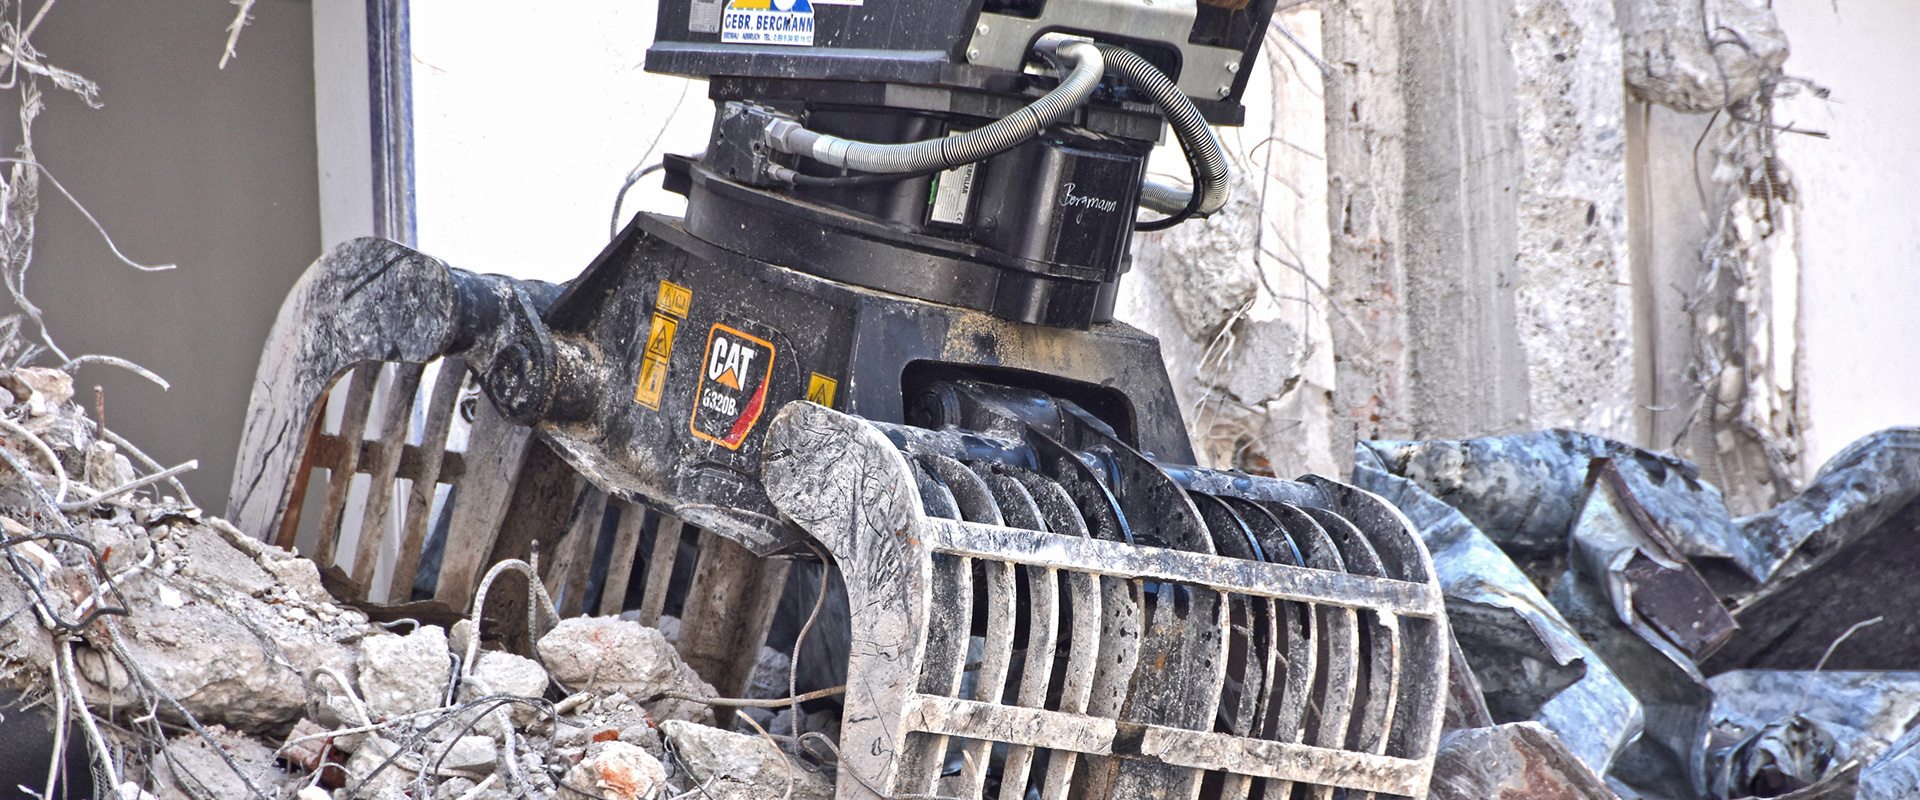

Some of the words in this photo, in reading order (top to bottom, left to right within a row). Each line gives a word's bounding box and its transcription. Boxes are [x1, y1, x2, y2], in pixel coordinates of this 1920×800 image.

[724, 13, 753, 30] GEBR.
[756, 15, 814, 32] BERGMANN
[1059, 182, 1117, 224] Bergmann
[709, 337, 755, 391] CAT
[702, 388, 737, 416] G320B
